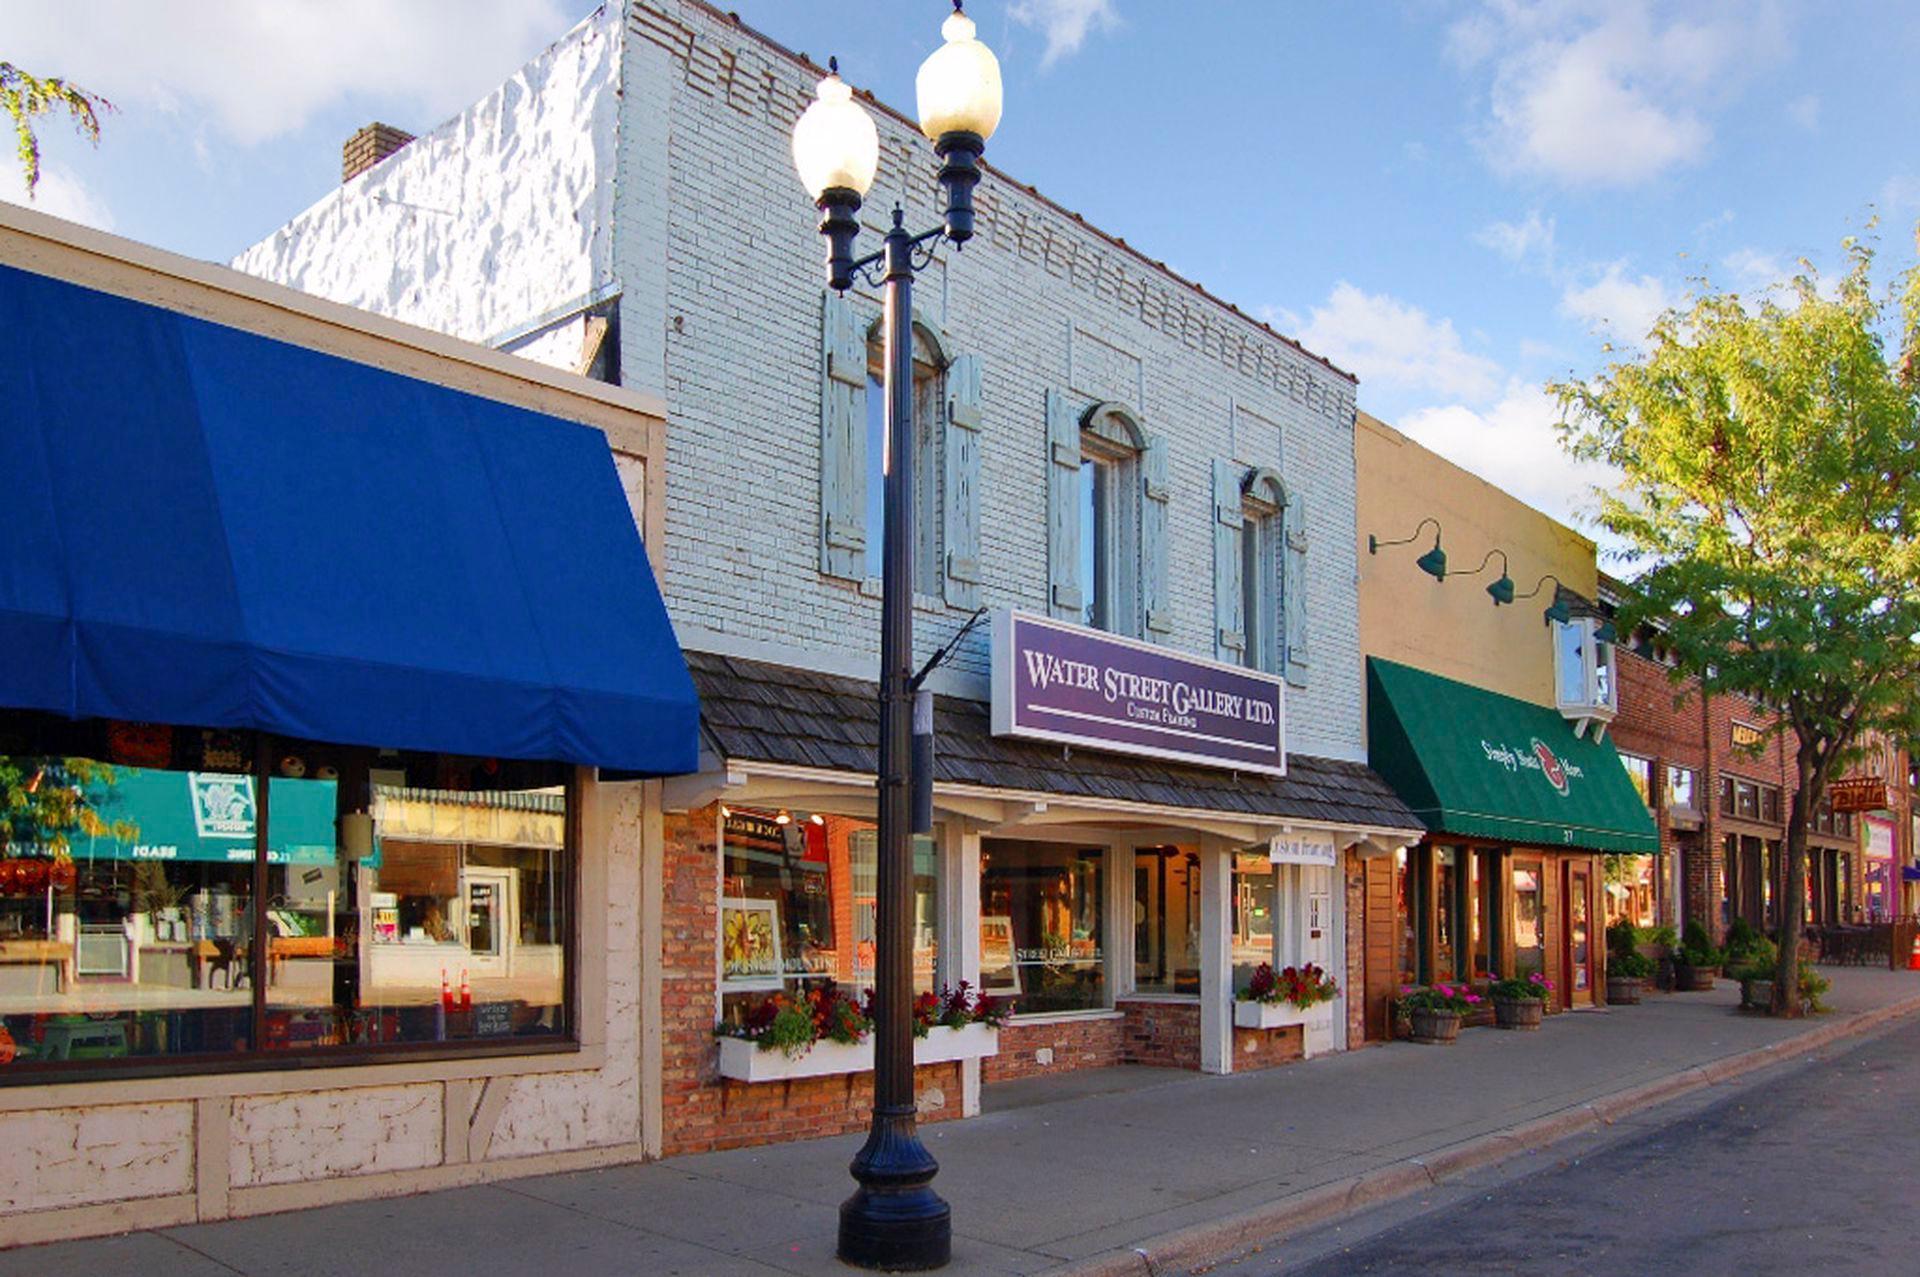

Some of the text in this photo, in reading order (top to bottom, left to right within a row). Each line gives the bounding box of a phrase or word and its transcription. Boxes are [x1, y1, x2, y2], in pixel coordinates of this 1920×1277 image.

[1023, 649, 1100, 691] WATER
[1104, 667, 1173, 705] STREET
[1172, 682, 1244, 716] GALLERY
